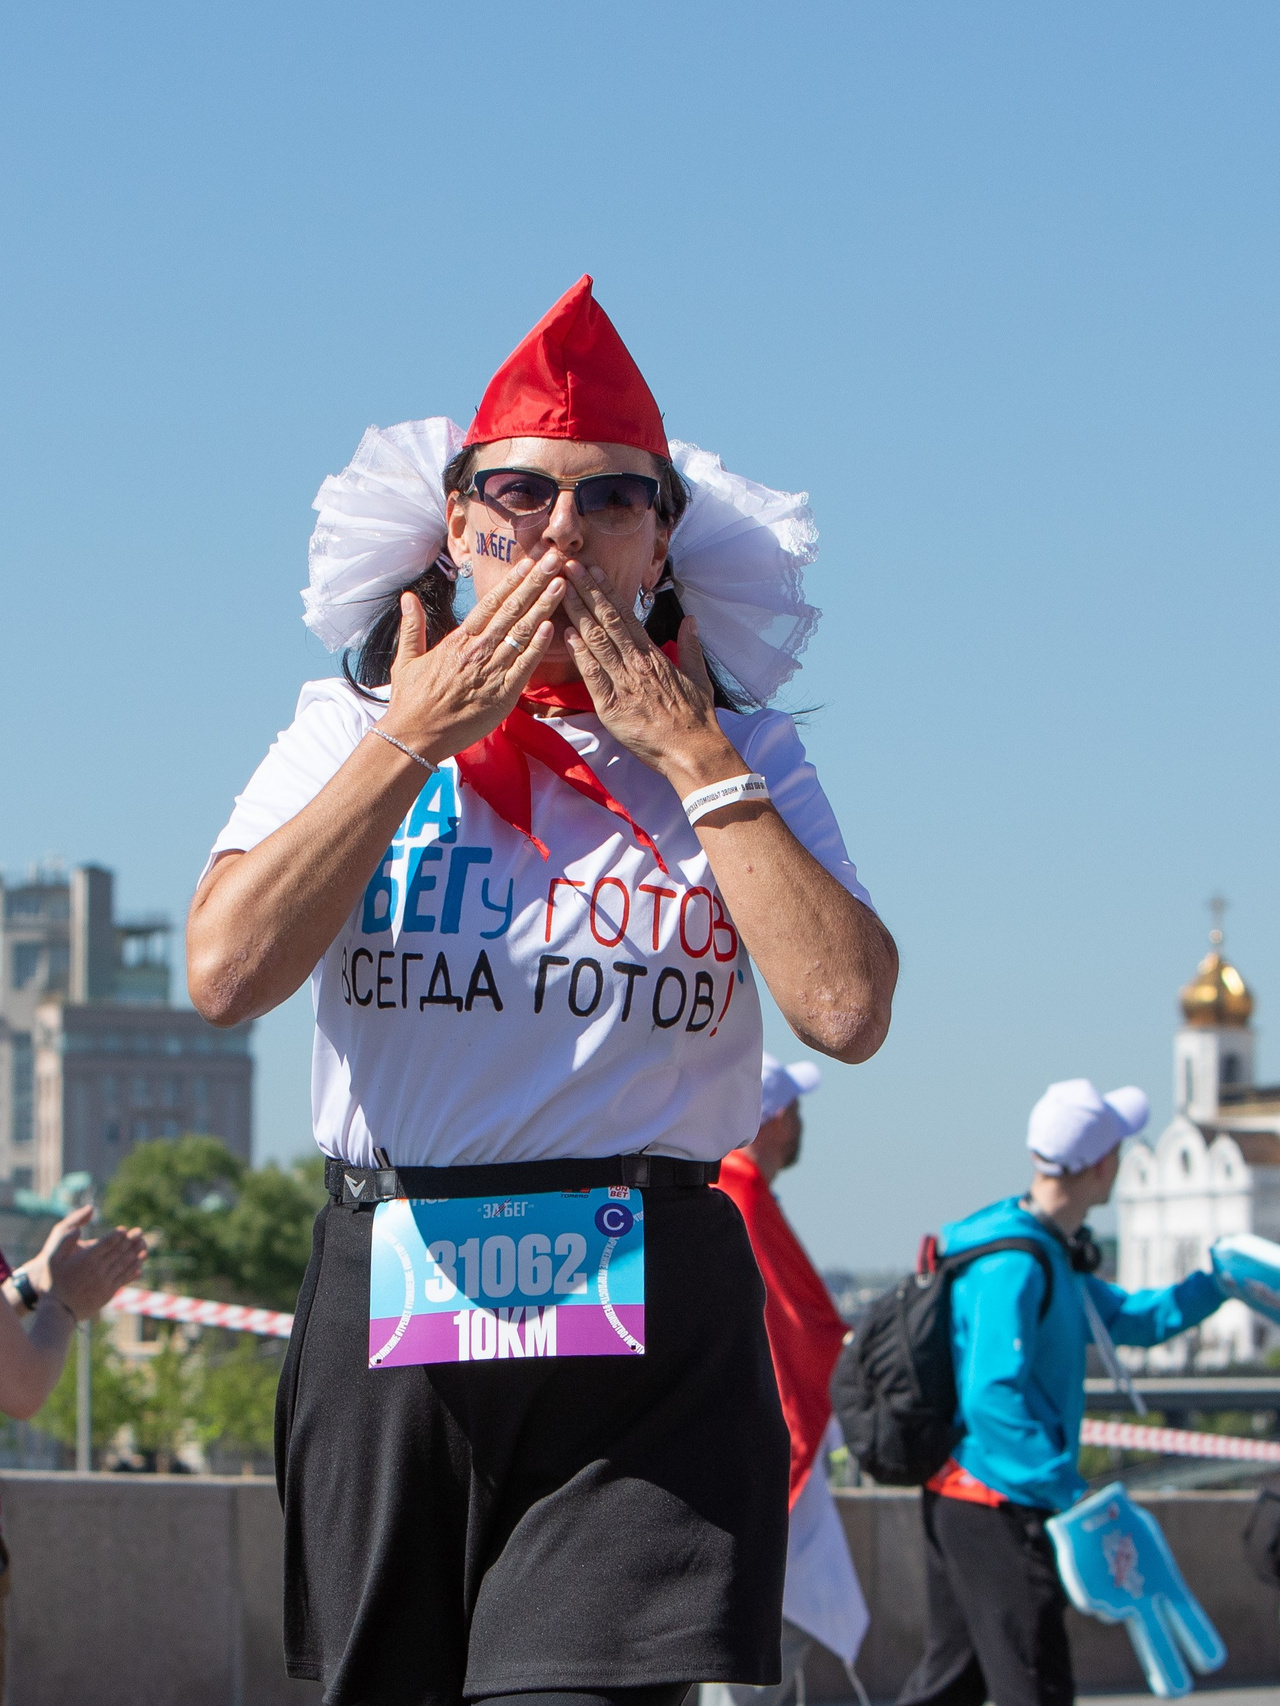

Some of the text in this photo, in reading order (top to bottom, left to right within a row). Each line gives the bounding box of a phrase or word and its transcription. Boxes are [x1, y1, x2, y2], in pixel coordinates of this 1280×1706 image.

[490, 532, 517, 563] БЕГ
[544, 876, 739, 963] ГОТОВ
[340, 946, 736, 1038] ВСЕГДА ГОТОВ!
[424, 1232, 588, 1303] 31062
